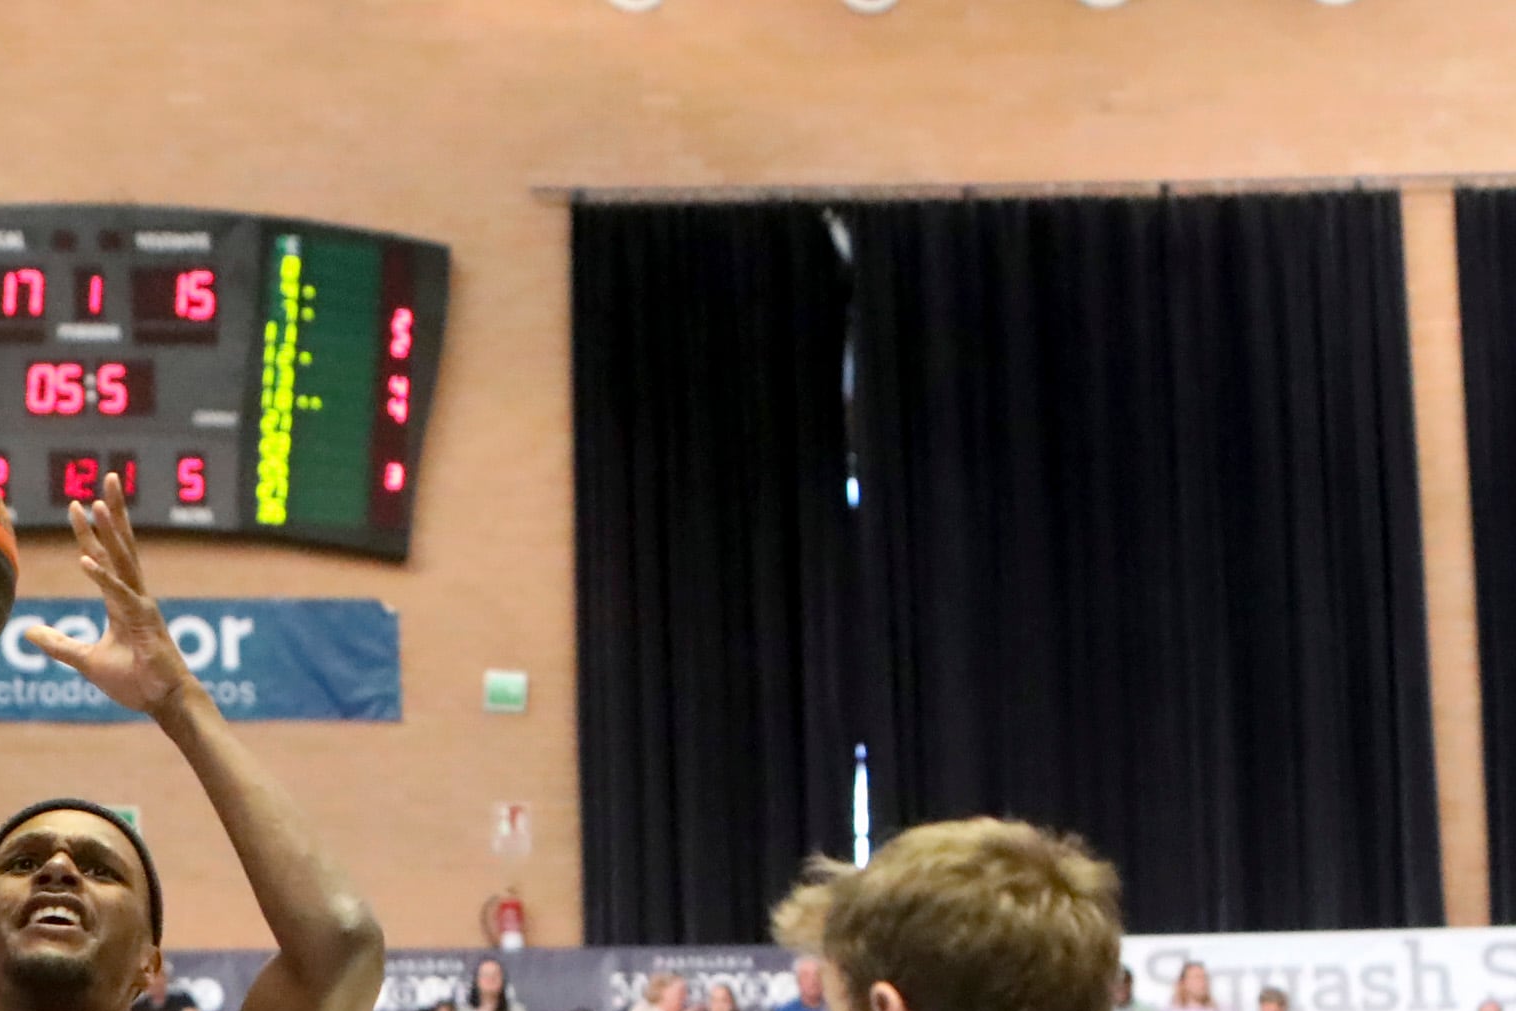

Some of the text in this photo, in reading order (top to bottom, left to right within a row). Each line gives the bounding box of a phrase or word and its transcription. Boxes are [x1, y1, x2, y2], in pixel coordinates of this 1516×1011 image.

[2, 268, 46, 317] 17
[89, 275, 103, 315] 1
[175, 269, 216, 321] 15
[177, 455, 206, 502] 5
